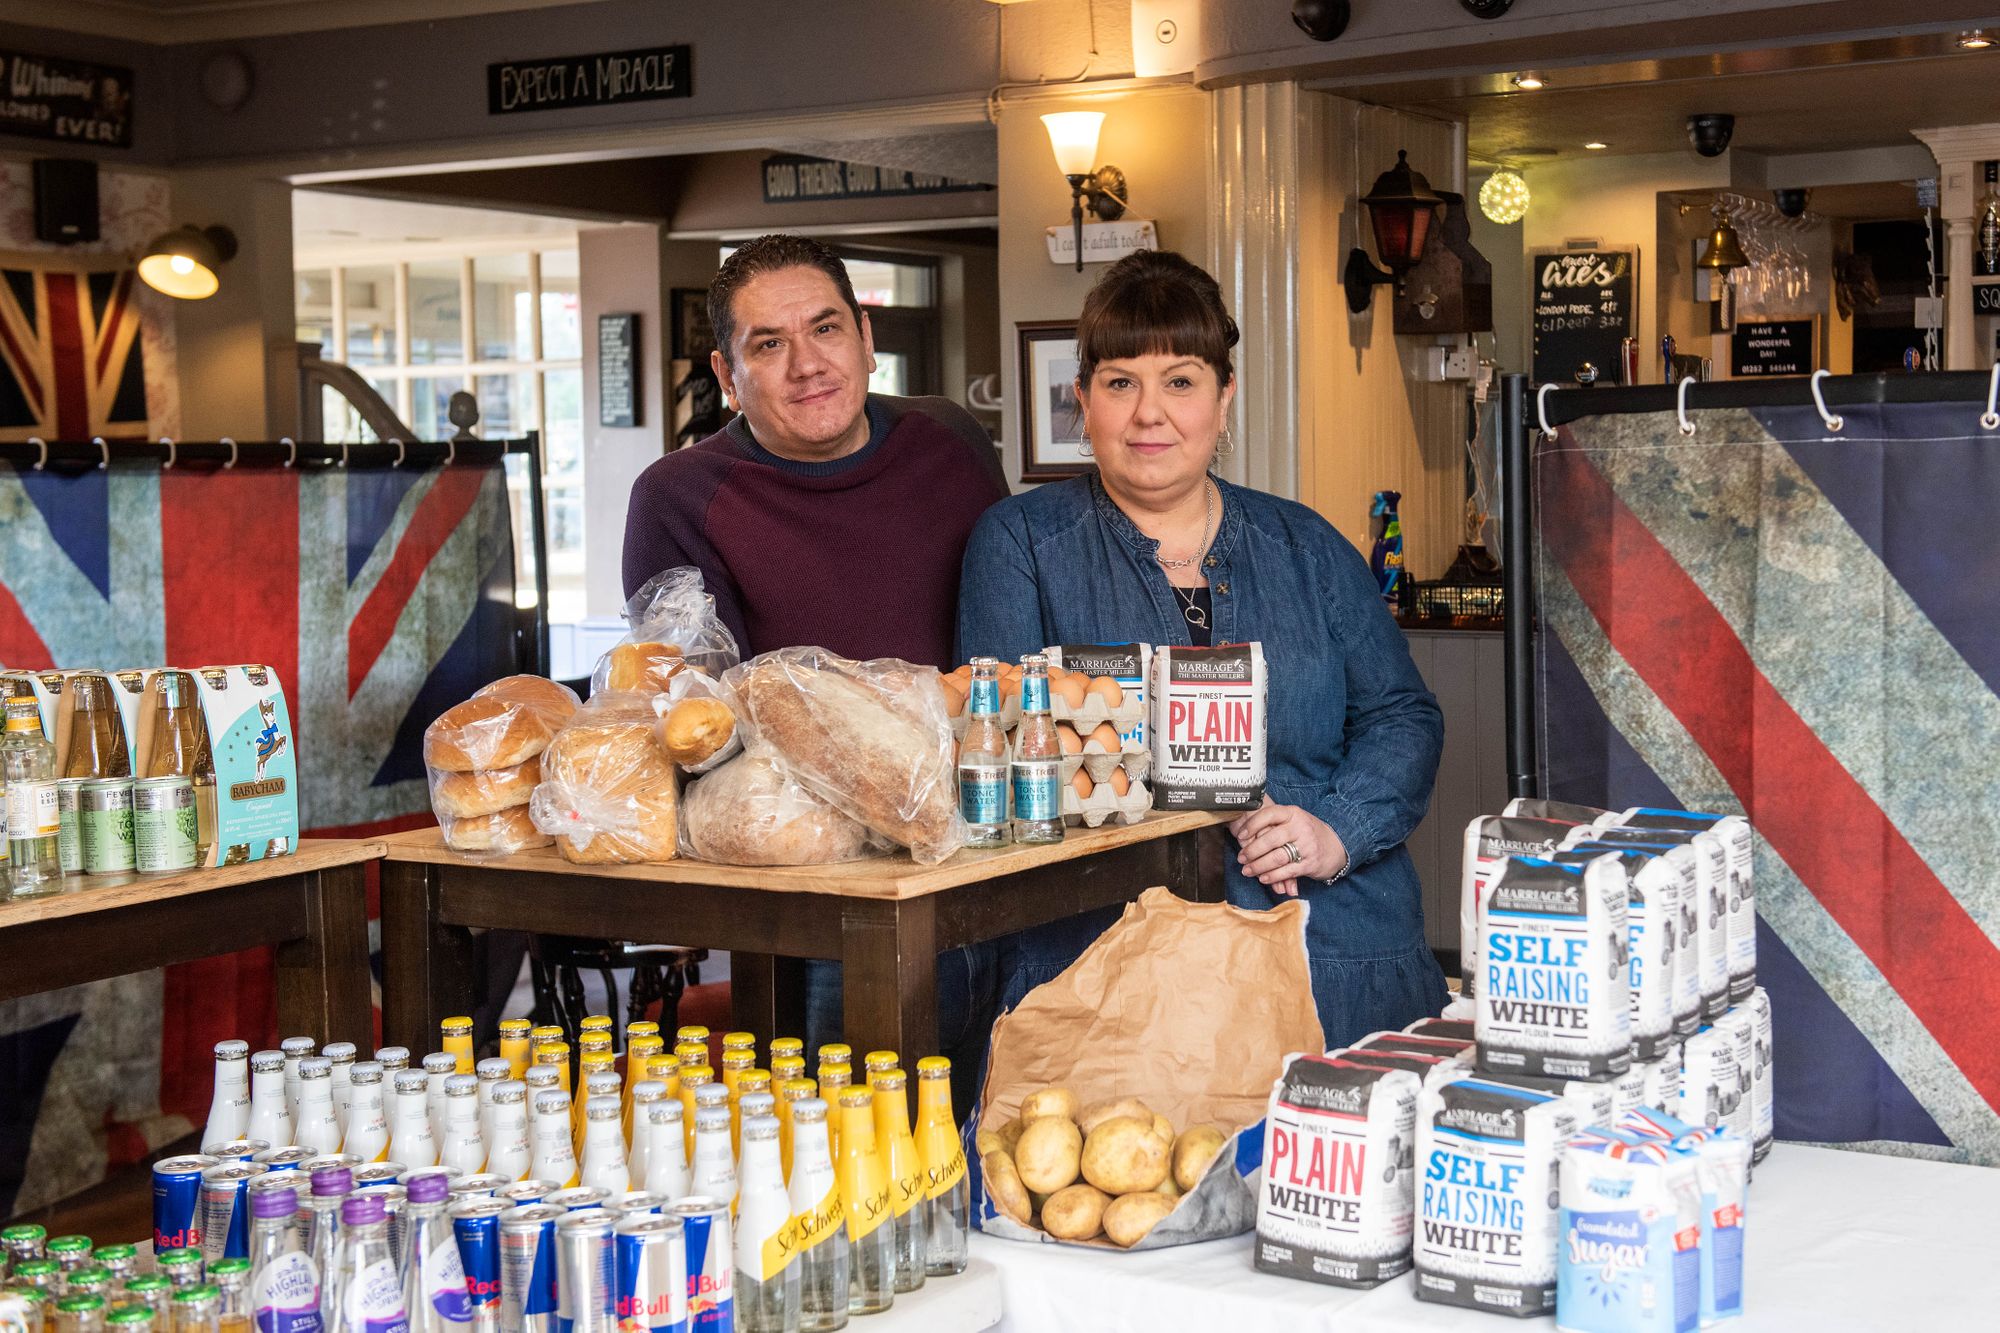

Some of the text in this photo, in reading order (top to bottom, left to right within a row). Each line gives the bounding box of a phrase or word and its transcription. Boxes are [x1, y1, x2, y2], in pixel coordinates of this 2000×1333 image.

[501, 54, 675, 109] EXPECT A MIRACLE
[766, 164, 797, 198] GOOD
[1539, 304, 1566, 315] LONDON
[1748, 339, 1791, 348] WONDERFUL
[1751, 326, 1787, 335] HAVE A
[1169, 701, 1252, 742] PLAIN
[1169, 744, 1251, 762] WHITE
[232, 780, 285, 798] BABYCHAM
[1488, 933, 1588, 967] SELF
[1488, 965, 1588, 1004] RAISING
[1489, 999, 1588, 1029] WHITE
[1302, 1123, 1328, 1135] FINEST
[1269, 1127, 1366, 1196] PLAIN
[1426, 1150, 1525, 1194] SELF
[1269, 1183, 1361, 1223] WHITE
[1423, 1182, 1524, 1231] RAISING
[1423, 1220, 1521, 1256] WHITE
[1566, 1228, 1652, 1284] Sugar
